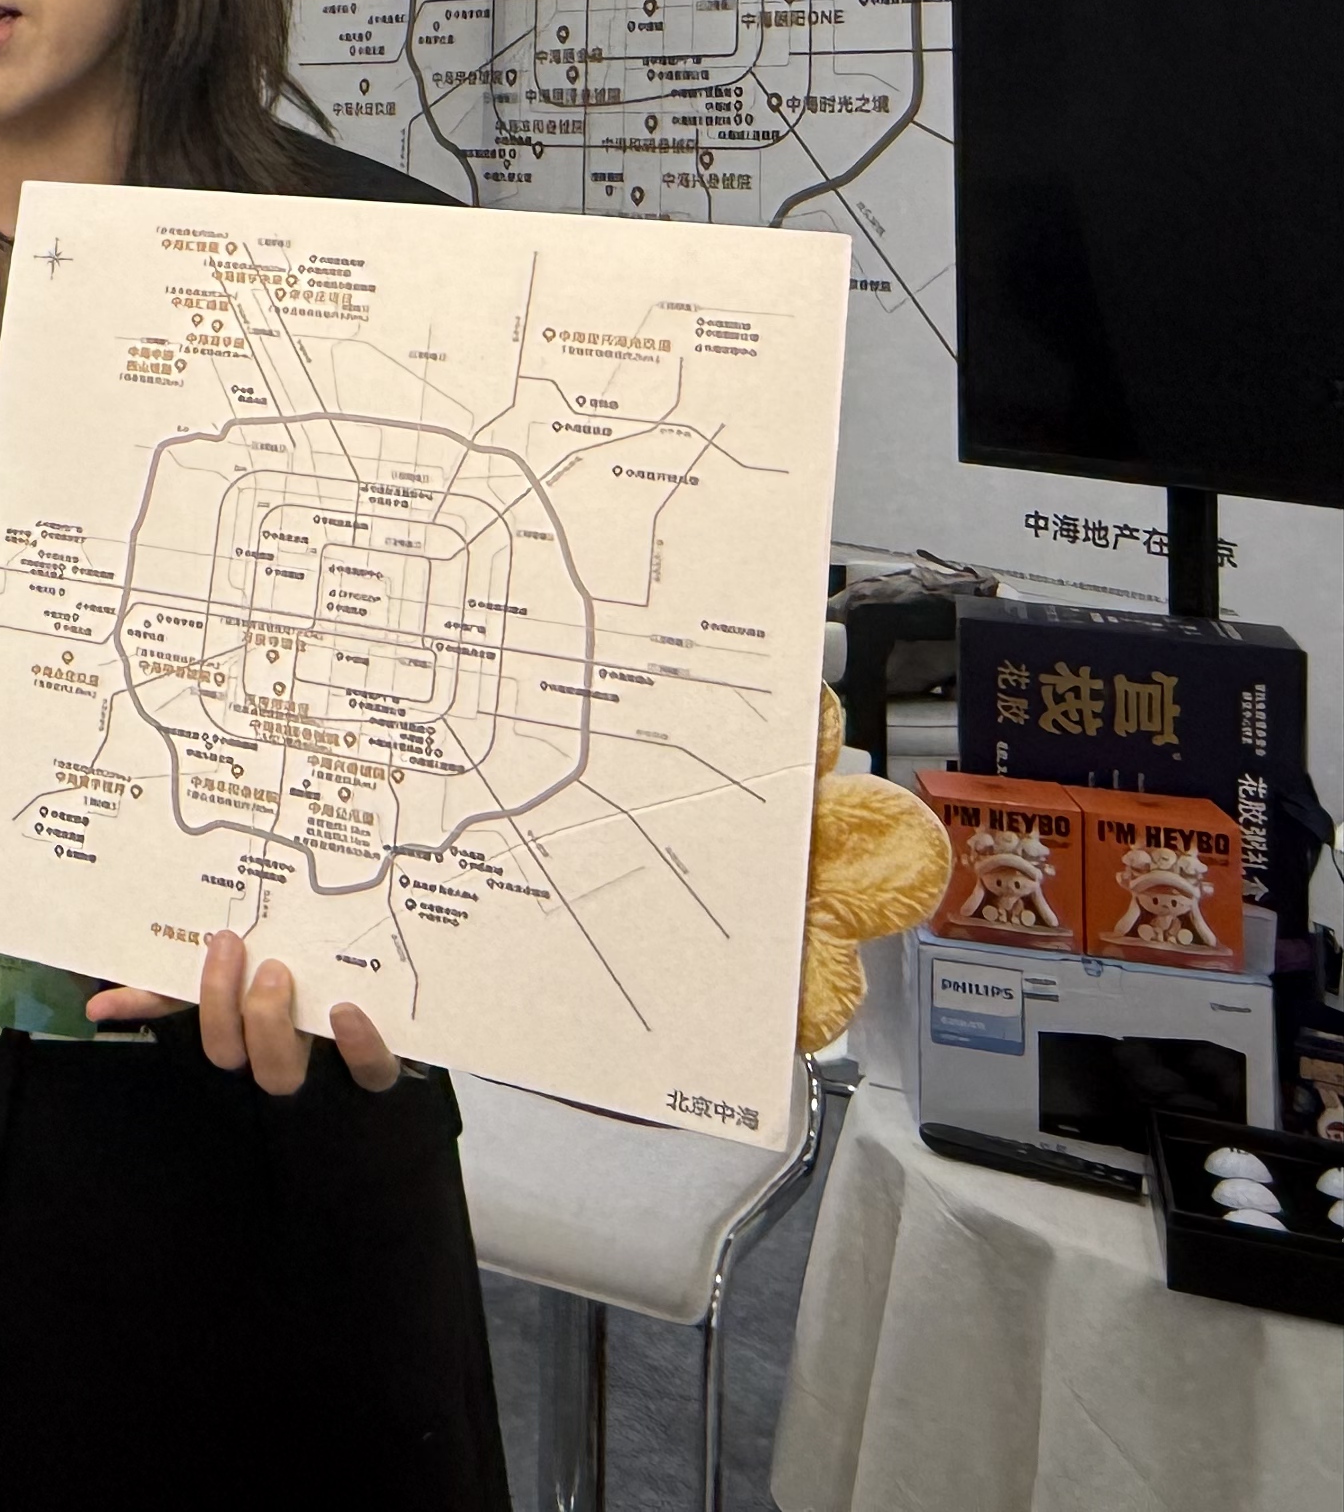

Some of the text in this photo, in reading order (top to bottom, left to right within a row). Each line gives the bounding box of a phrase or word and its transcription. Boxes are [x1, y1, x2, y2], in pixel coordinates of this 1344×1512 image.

[1024, 509, 1238, 569] 中海地产在京
[996, 659, 1031, 726] 花胶
[1037, 660, 1183, 747] 官栈
[943, 803, 1072, 838] I'M HEYBO
[1096, 819, 1231, 856] I'M HEYBO
[941, 978, 1015, 1001] PHILIPS
